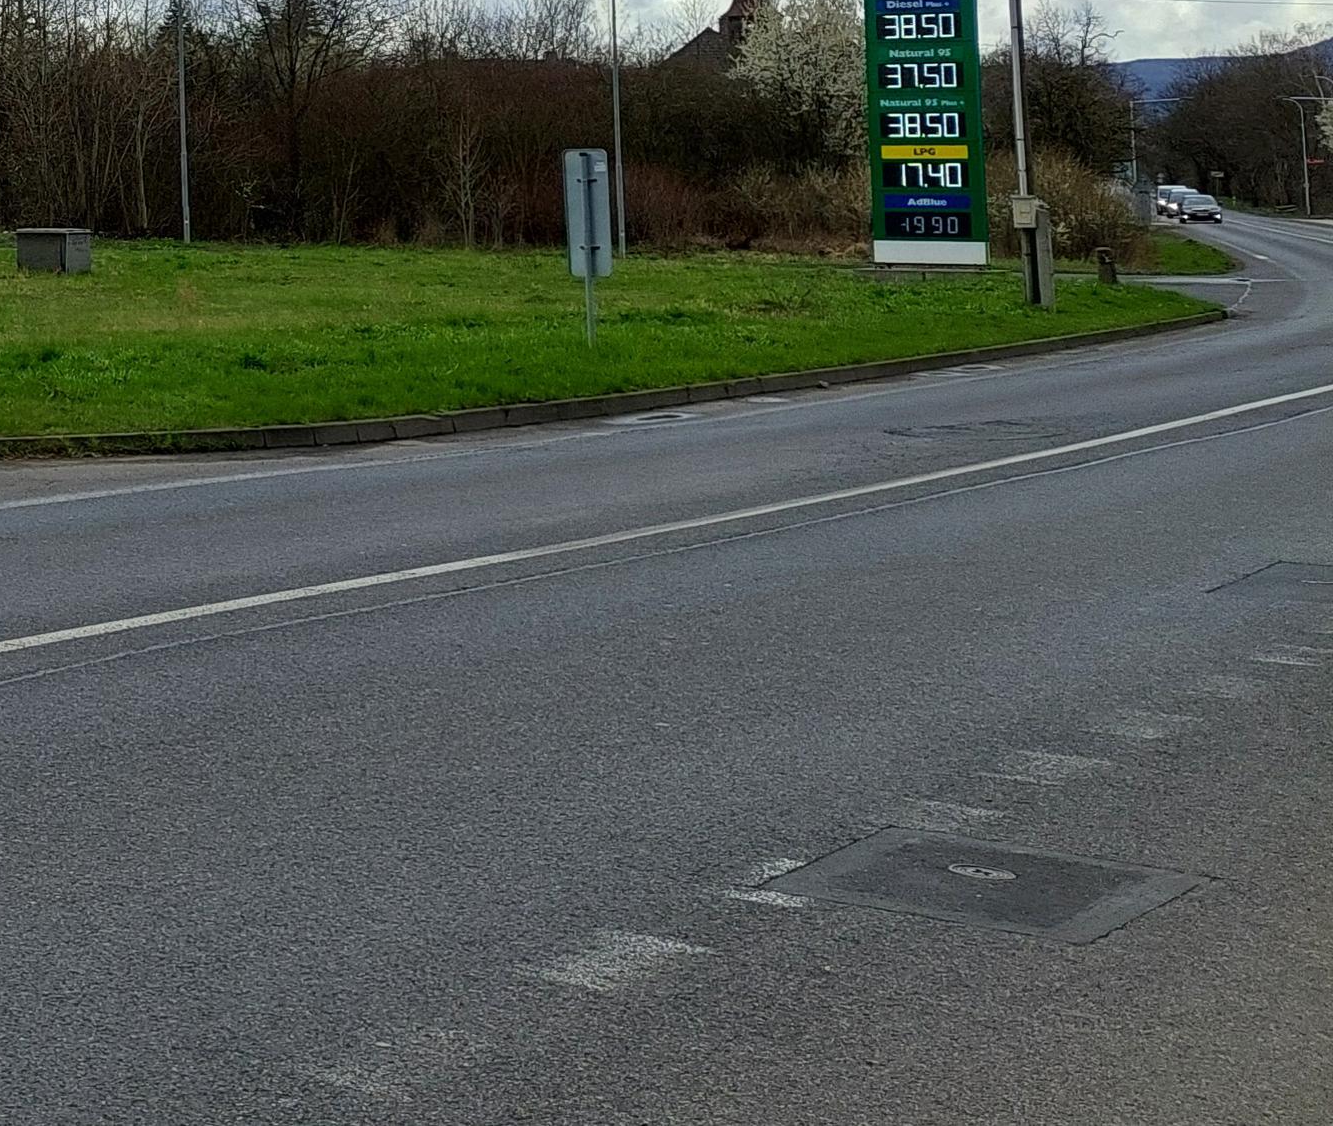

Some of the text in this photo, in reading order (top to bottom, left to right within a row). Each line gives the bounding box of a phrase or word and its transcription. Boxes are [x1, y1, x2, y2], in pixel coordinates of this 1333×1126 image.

[886, 0, 923, 9] Diesel
[882, 13, 955, 39] 38.50
[889, 48, 951, 58] Natural 95
[885, 62, 957, 89] 37.50
[879, 99, 921, 107] Natural
[886, 112, 959, 138] 38.50
[913, 147, 936, 155] LPG
[901, 162, 962, 187] 17.40
[907, 198, 947, 207] AdBlue
